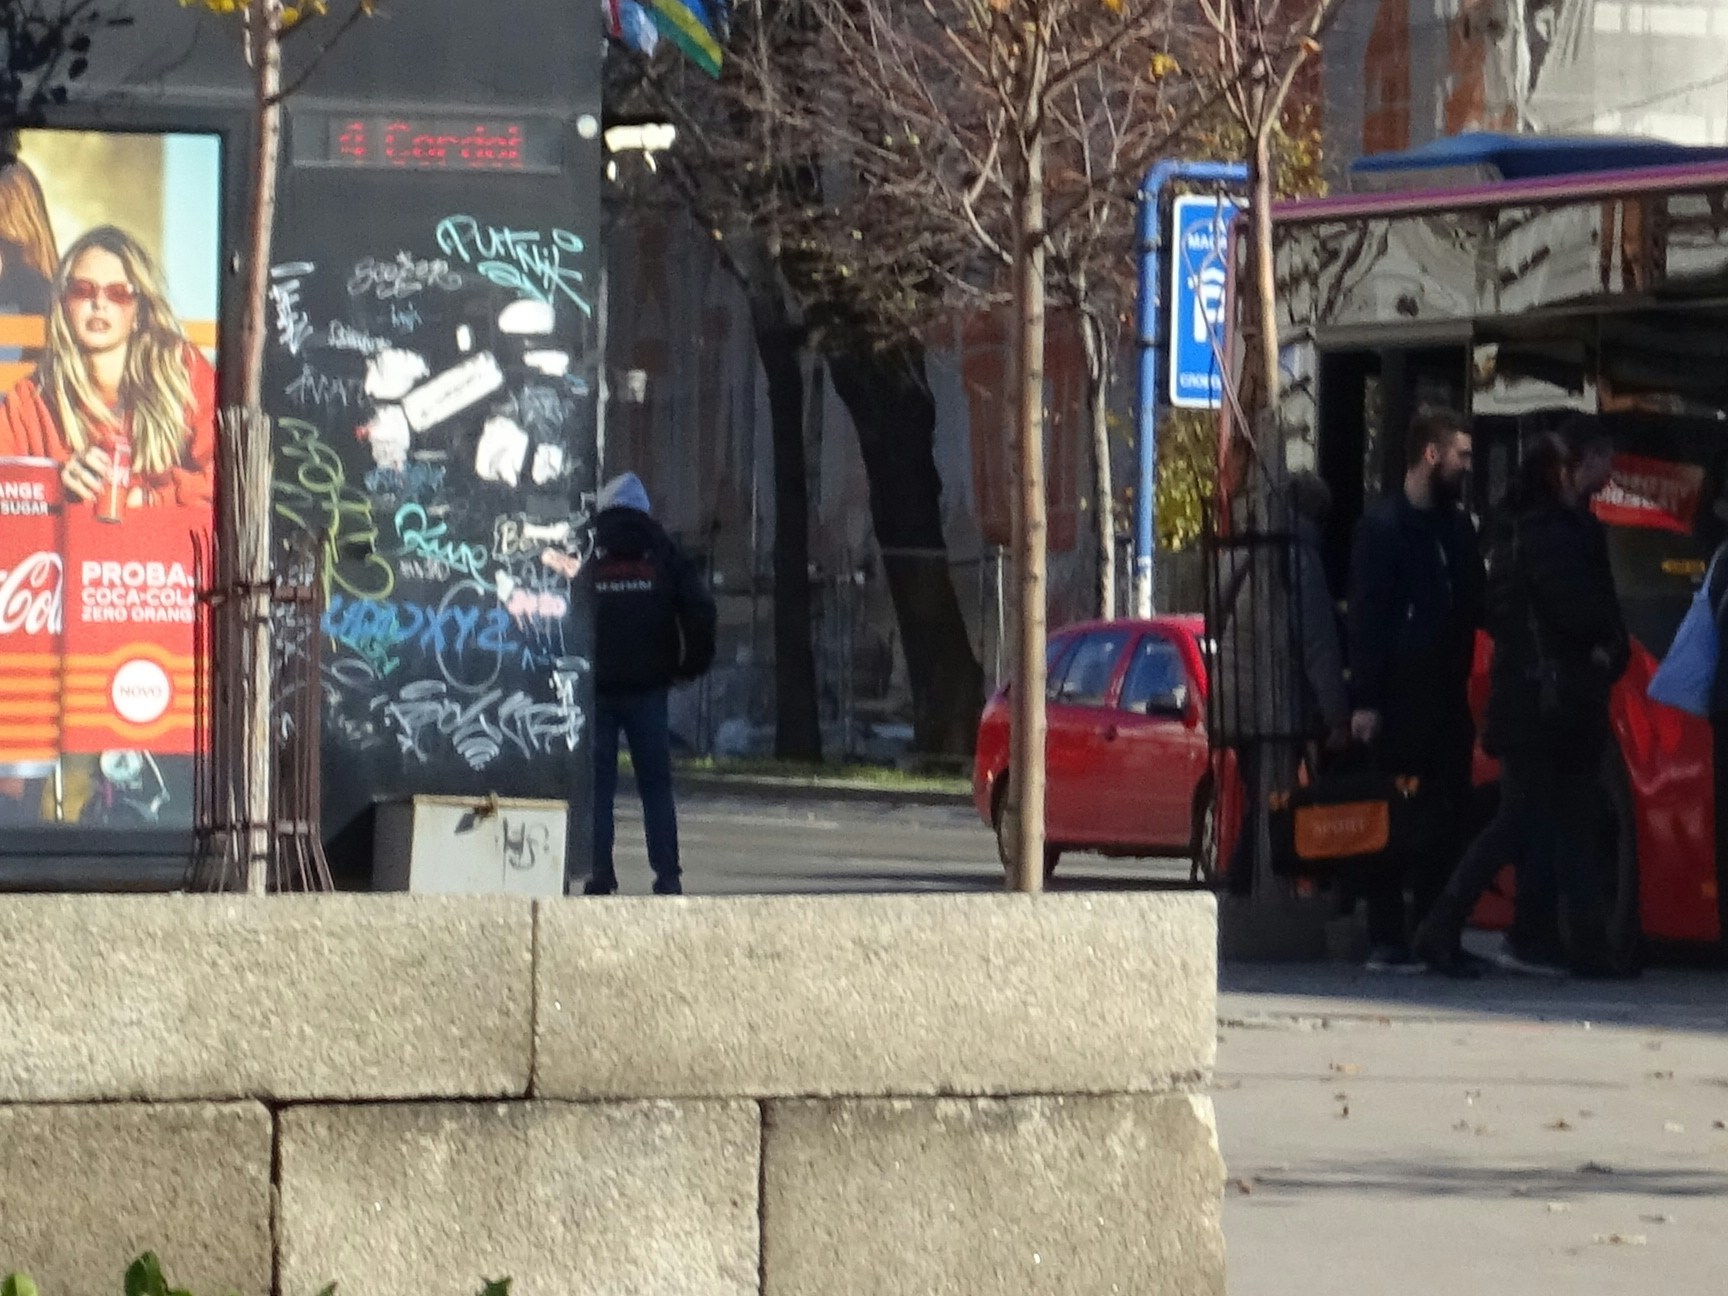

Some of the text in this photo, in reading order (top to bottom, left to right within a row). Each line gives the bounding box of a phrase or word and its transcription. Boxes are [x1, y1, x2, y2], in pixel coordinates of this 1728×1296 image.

[1, 499, 49, 516] SUGAR
[82, 605, 196, 624] ZERO ORANG
[119, 685, 162, 698] NOVO
